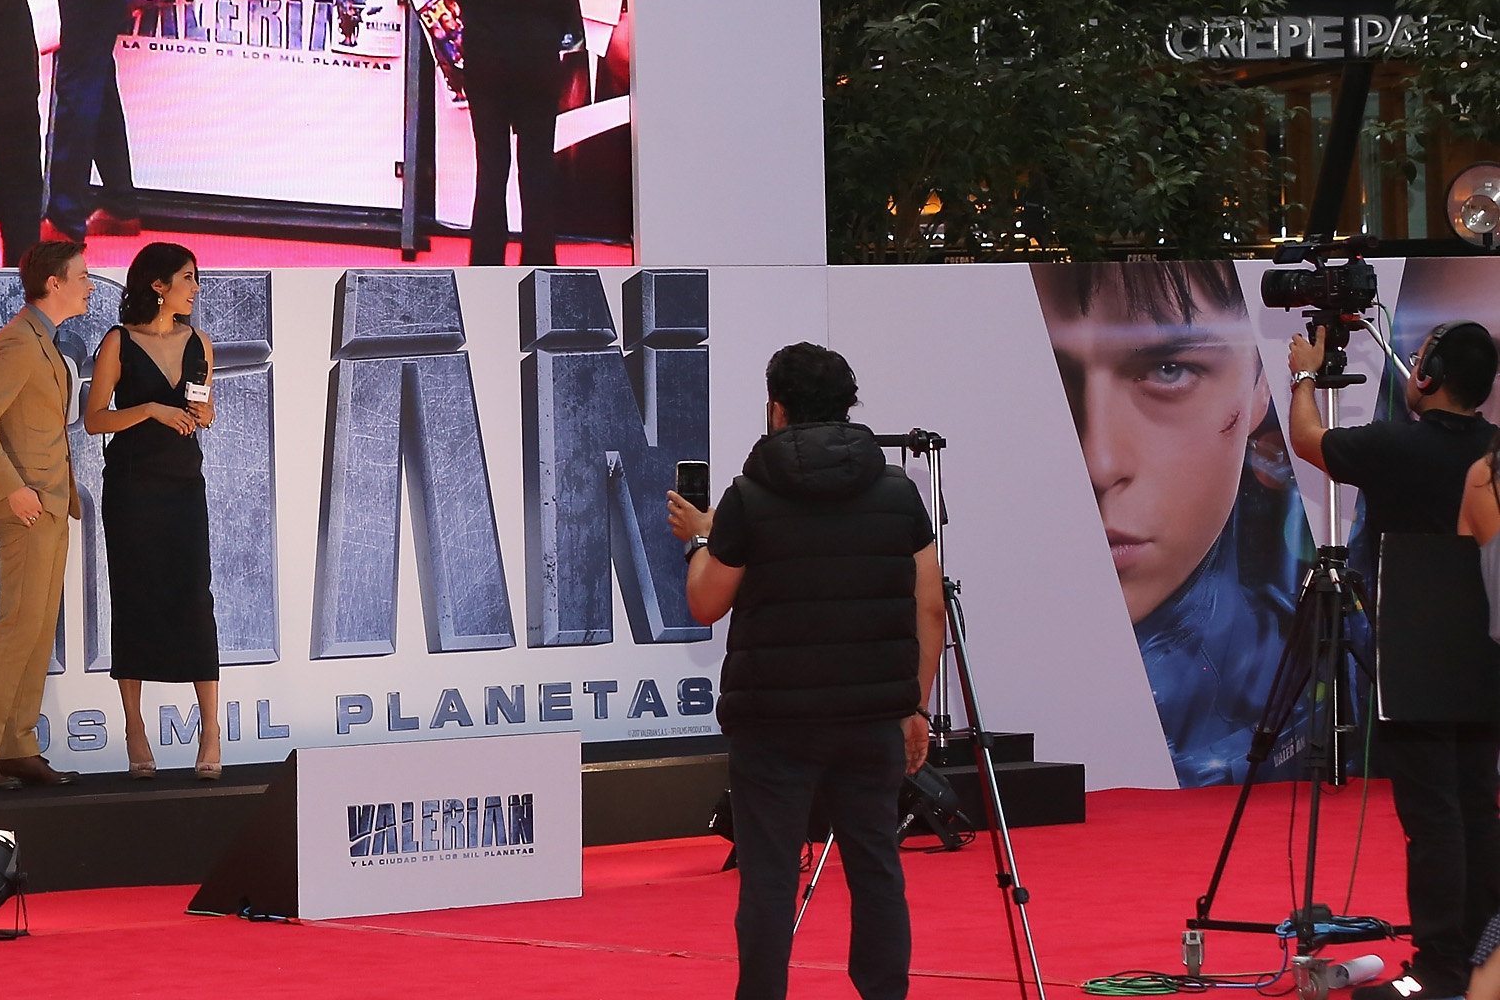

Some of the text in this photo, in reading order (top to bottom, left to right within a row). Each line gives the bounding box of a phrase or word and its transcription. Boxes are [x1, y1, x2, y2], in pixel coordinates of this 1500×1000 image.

[336, 677, 714, 735] PLANETAS
[347, 793, 534, 858] VALERIAN
[379, 857, 417, 865] CIUDAD
[484, 848, 534, 857] PLANETAS
